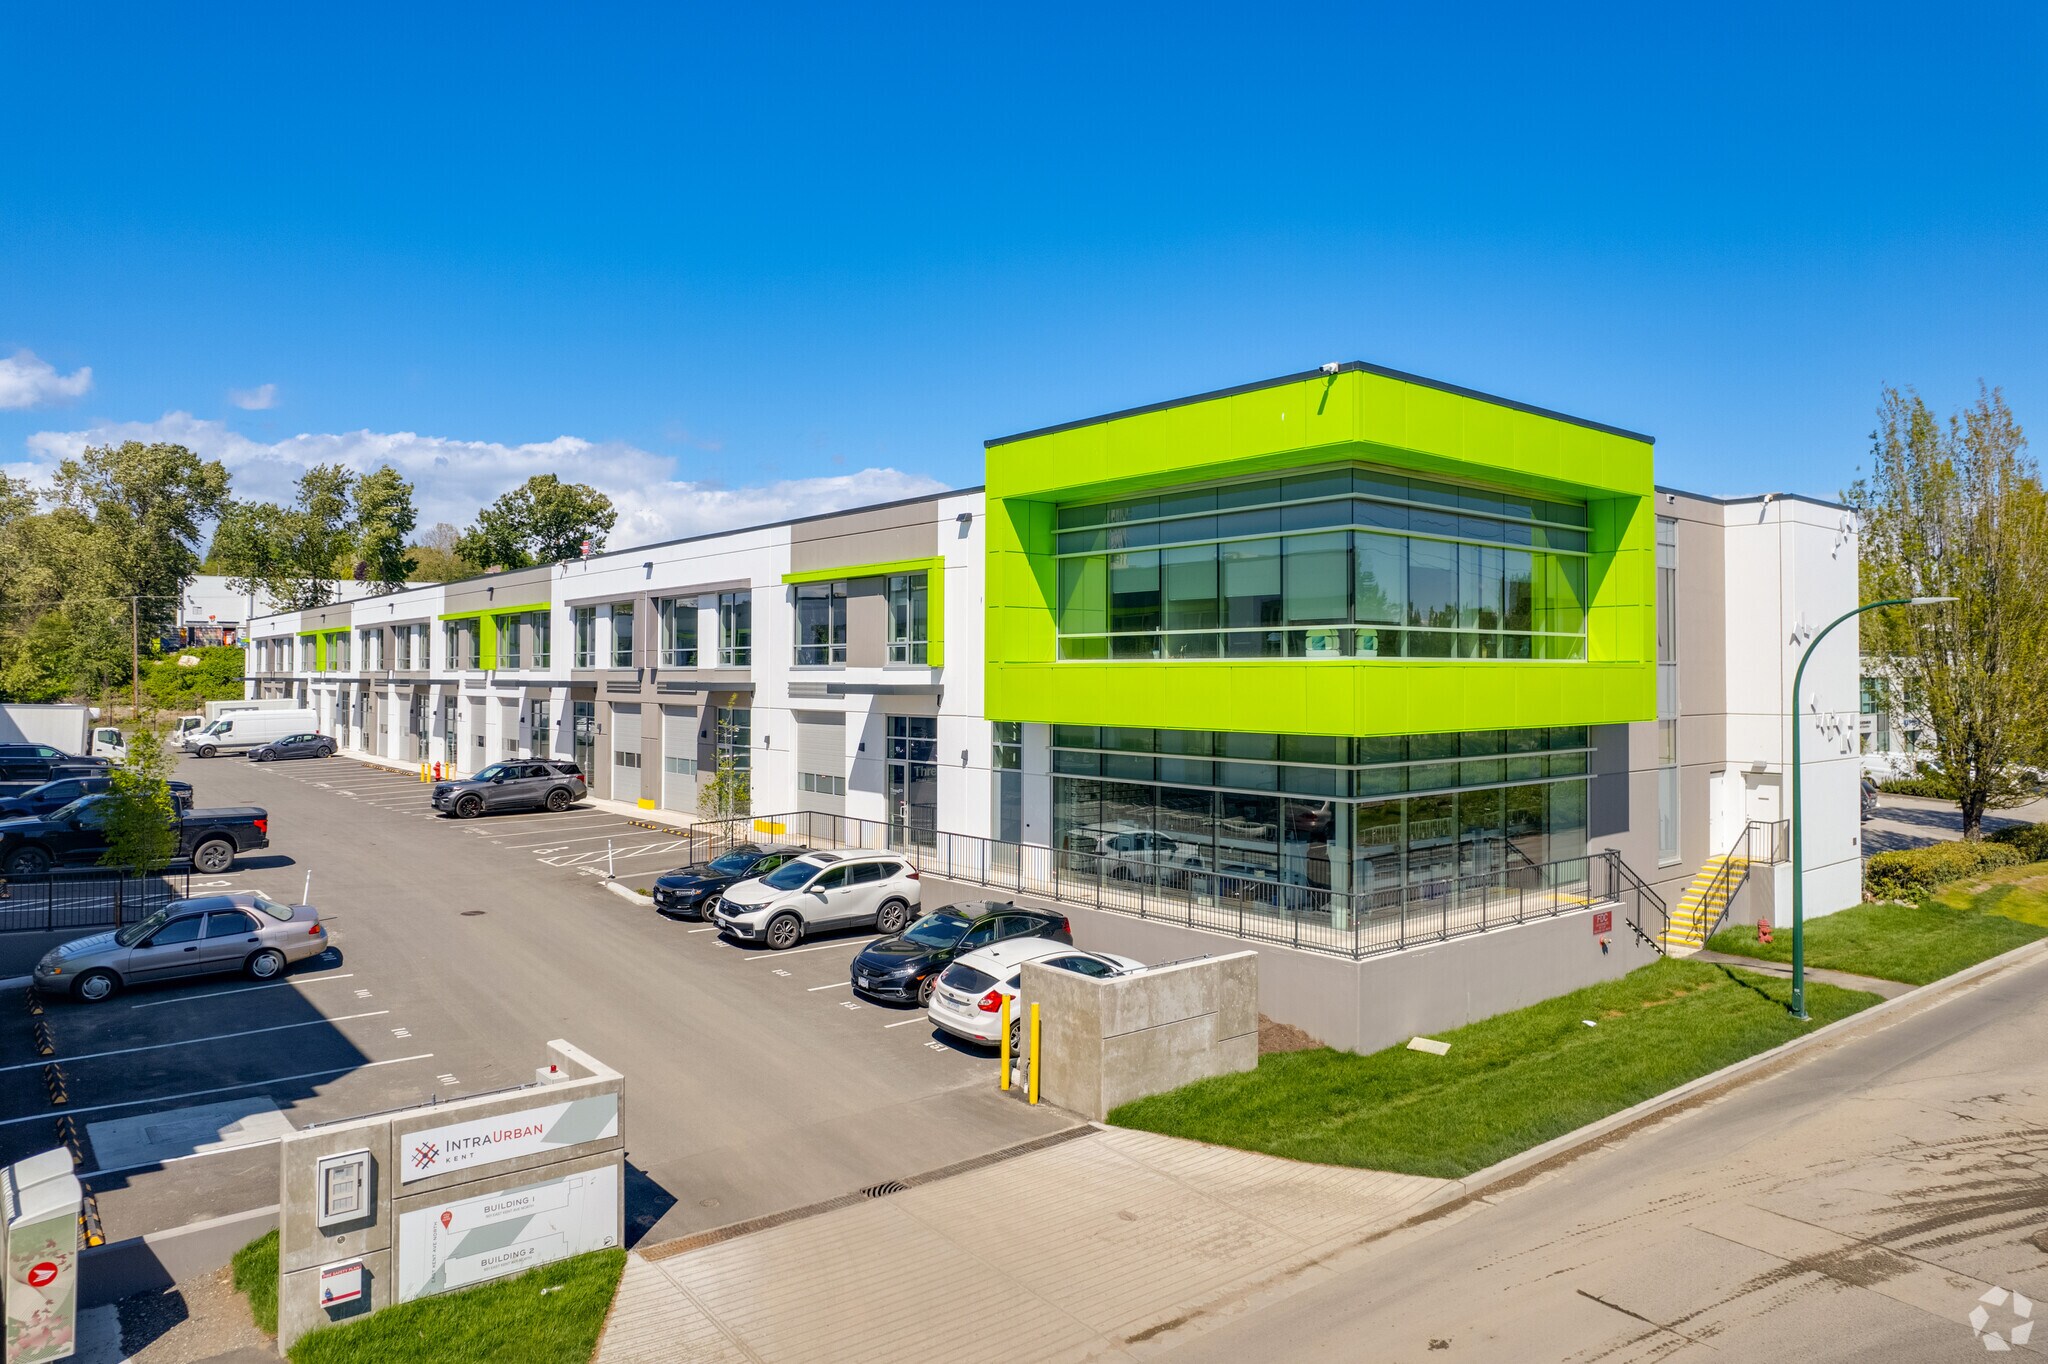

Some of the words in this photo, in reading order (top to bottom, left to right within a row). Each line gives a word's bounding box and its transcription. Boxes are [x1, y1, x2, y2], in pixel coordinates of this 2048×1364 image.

[1596, 913, 1609, 924] FDC
[391, 1027, 412, 1039] 101
[436, 1073, 461, 1086] 101
[446, 1152, 474, 1163] KENT
[484, 1196, 529, 1213] BUILDING
[481, 1249, 526, 1267] BUILDING
